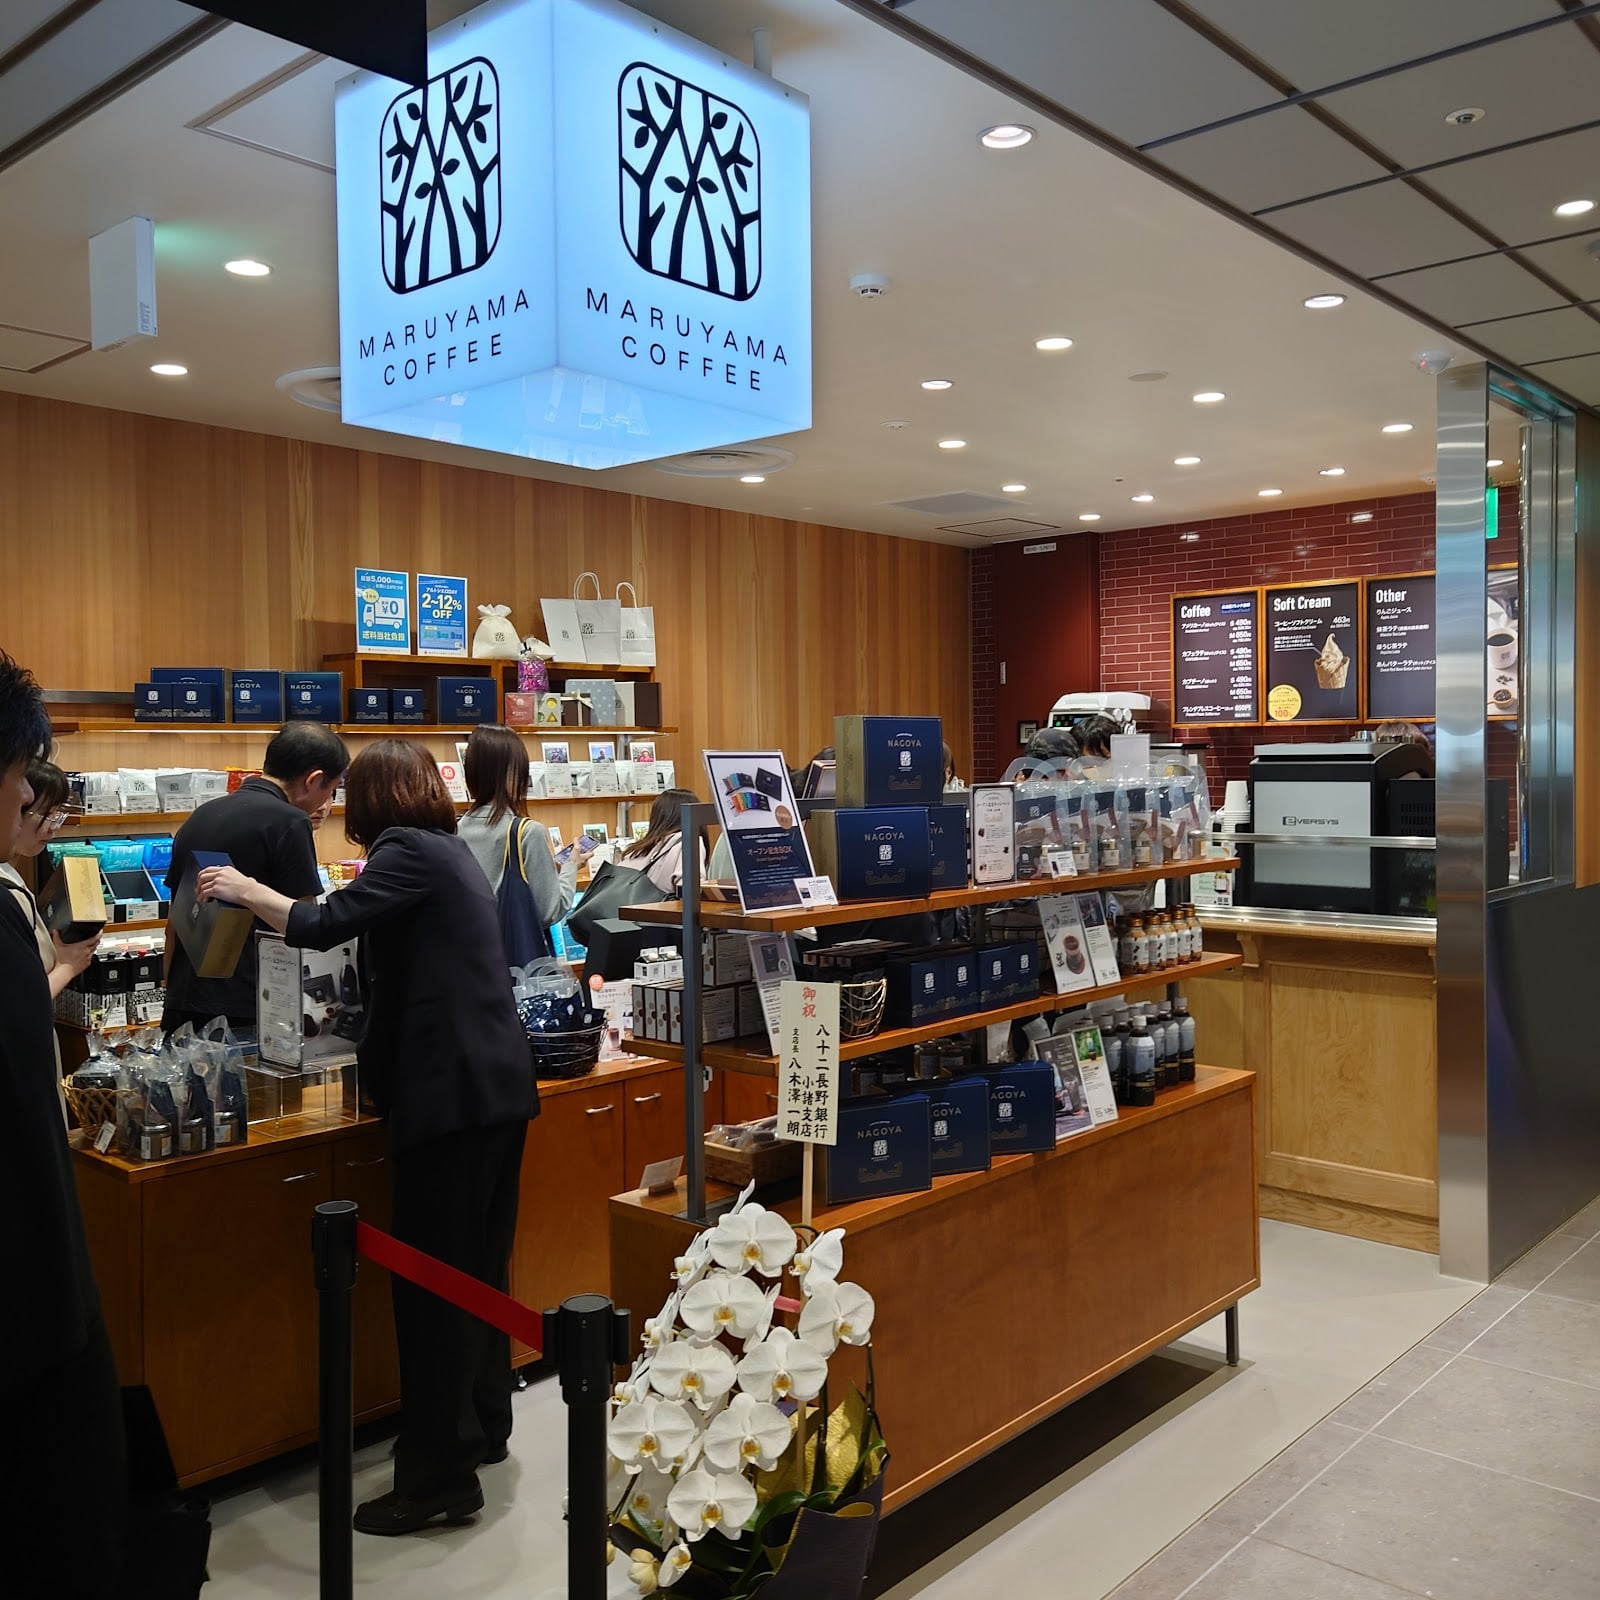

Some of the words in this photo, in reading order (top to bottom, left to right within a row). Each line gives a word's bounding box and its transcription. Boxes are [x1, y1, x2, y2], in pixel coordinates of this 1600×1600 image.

[359, 289, 529, 359] MARUYAMA
[586, 287, 788, 366] MARUYAMA
[384, 334, 502, 385] COFFEE
[622, 337, 761, 391] COFFEE
[1274, 597, 1296, 612] Soft
[1298, 596, 1332, 610] Cream
[1375, 588, 1407, 604] Other
[432, 609, 453, 619] OFF
[1181, 605, 1211, 618] Coffee
[887, 739, 922, 747] NAGOYA
[864, 832, 905, 841] NAGOYA
[802, 986, 817, 1018] 御祝
[814, 1024, 830, 1139] 八十二長野銀行
[787, 1057, 801, 1137] 八木澤一朗
[990, 1091, 1026, 1100] AGOYA
[800, 1076, 814, 1138] 小諸支店
[932, 1107, 962, 1118] GOYA
[857, 1125, 902, 1139] NAGOYA
